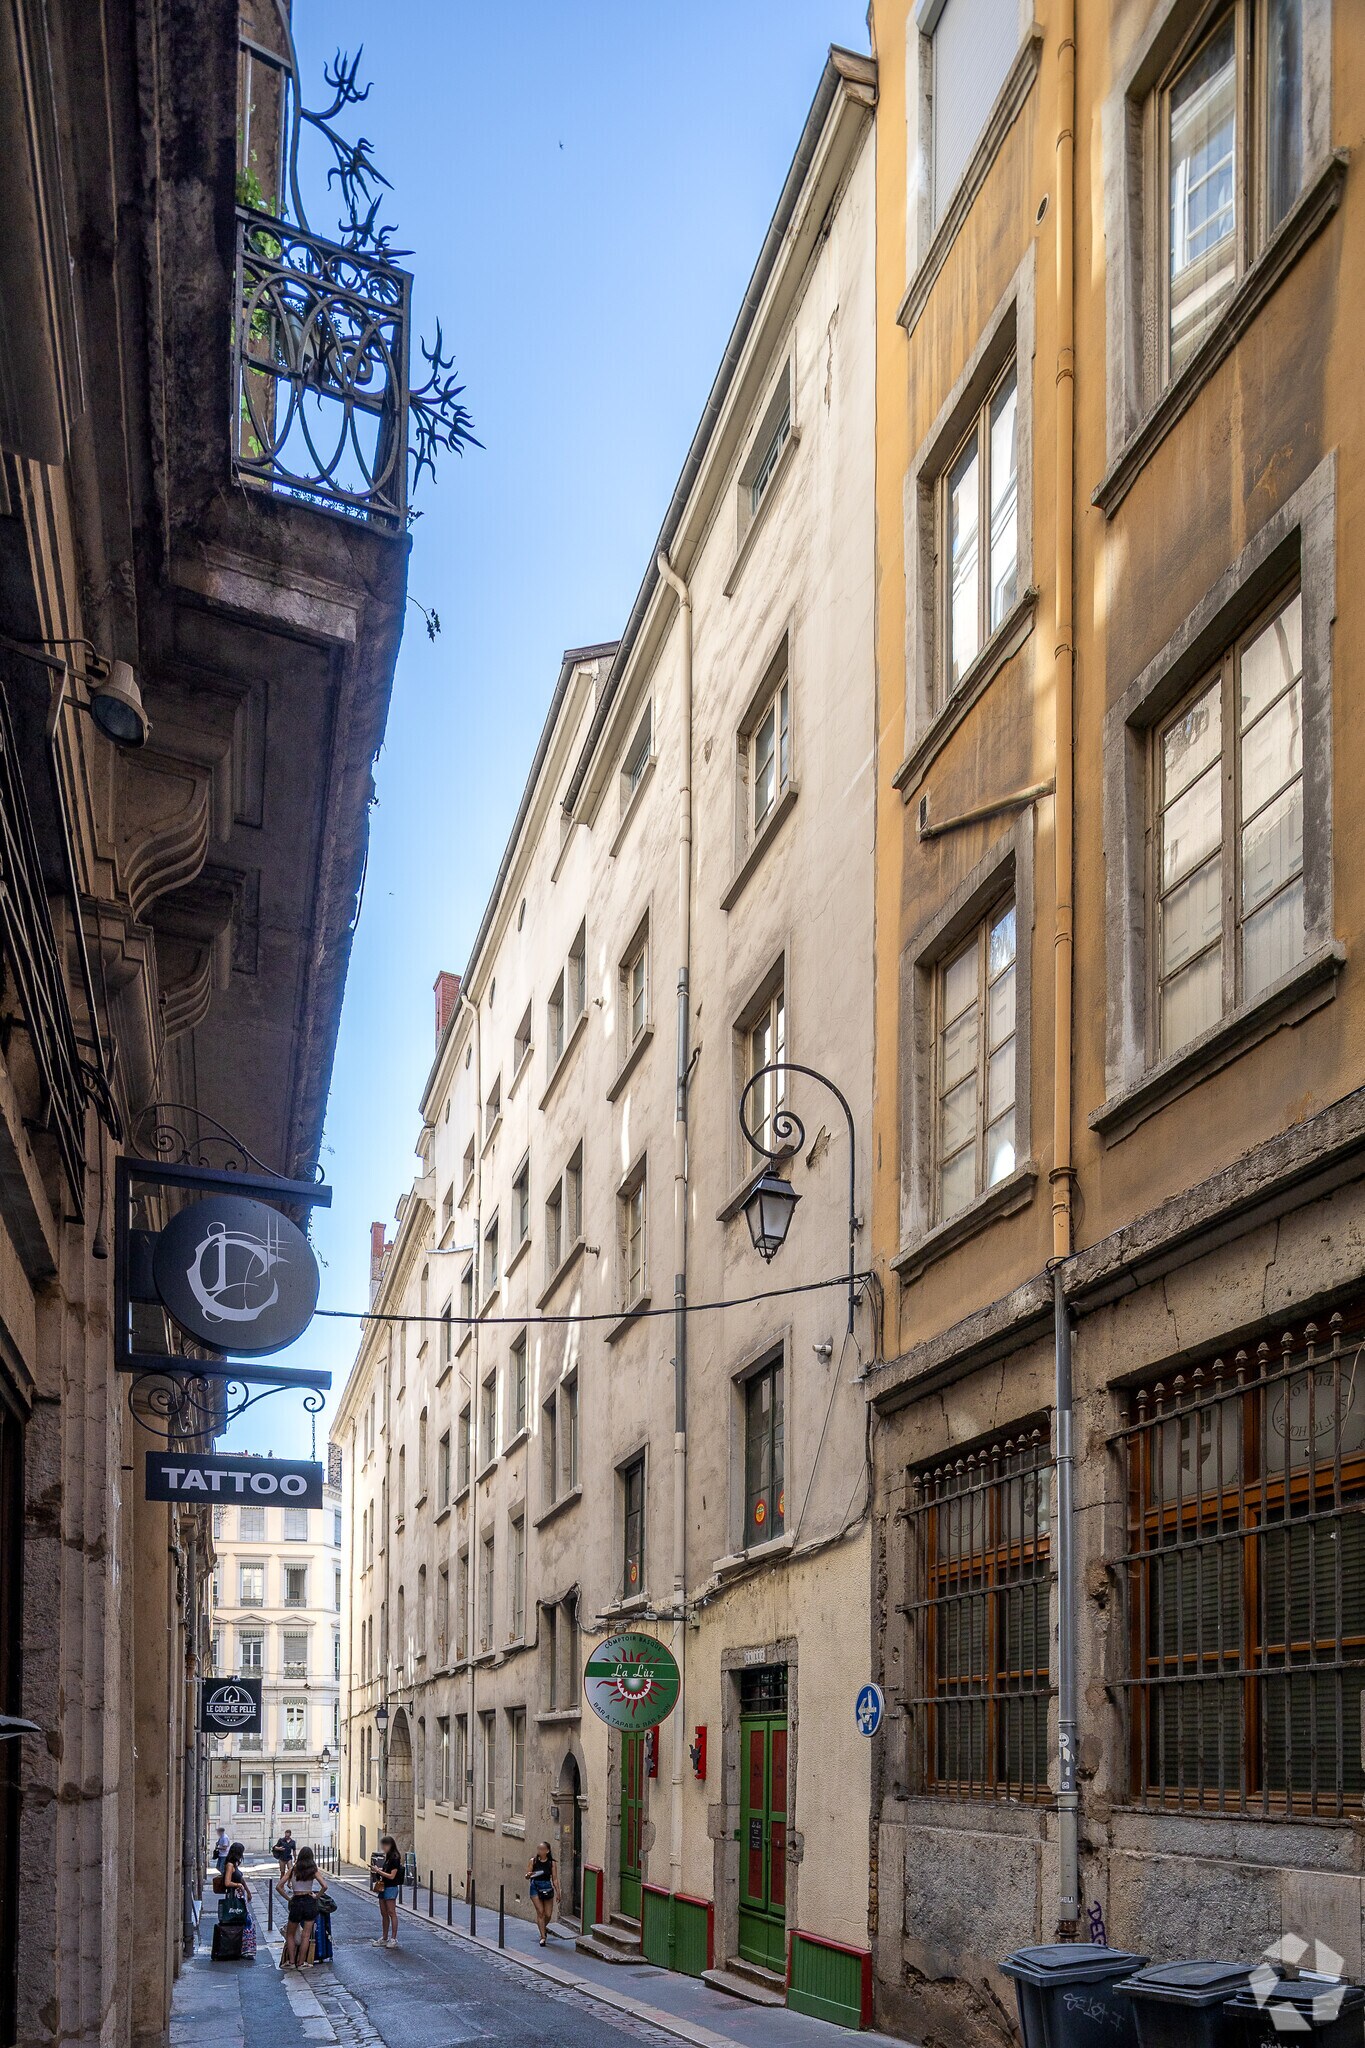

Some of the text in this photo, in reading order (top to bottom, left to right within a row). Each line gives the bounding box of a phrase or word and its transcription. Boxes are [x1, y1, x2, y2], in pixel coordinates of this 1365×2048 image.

[160, 1467, 308, 1496] TATTOO
[639, 1635, 662, 1652] BASQUE
[611, 1663, 628, 1678] La
[206, 1705, 214, 1713] LE
[214, 1705, 230, 1713] COUP
[239, 1705, 257, 1714] PELLE
[593, 1702, 605, 1716] BAR
[611, 1718, 634, 1729] TAPAS
[642, 1718, 657, 1728] BAR
